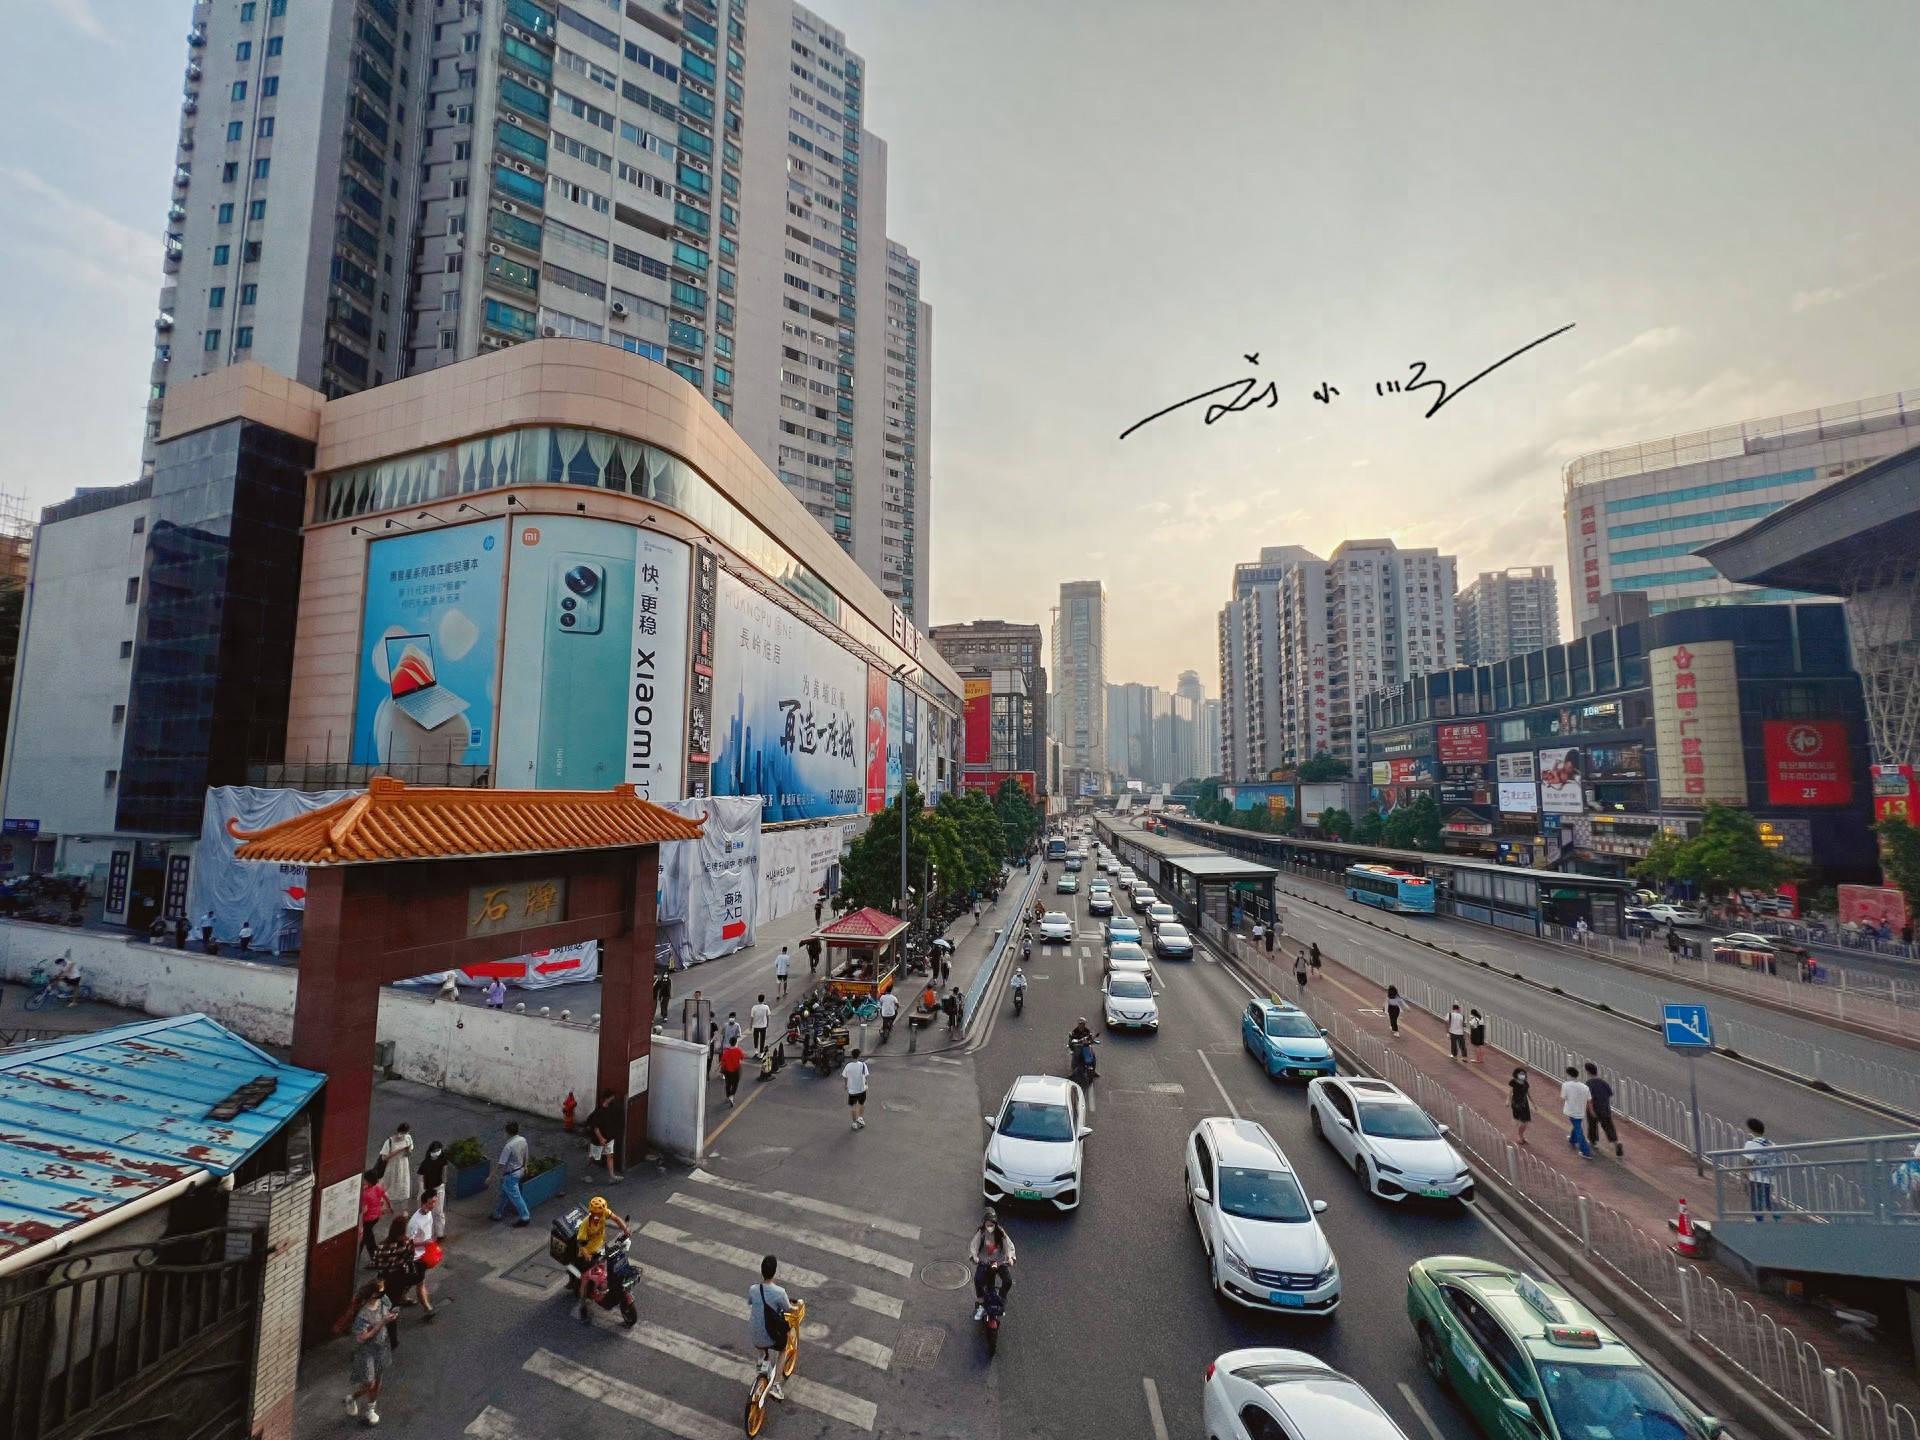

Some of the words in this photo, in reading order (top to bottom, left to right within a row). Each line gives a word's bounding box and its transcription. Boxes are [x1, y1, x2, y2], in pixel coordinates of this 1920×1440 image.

[725, 590, 772, 628] HUANGPU
[1802, 787, 1818, 798] 2F
[724, 891, 743, 906] 商场
[724, 907, 743, 921] 入口
